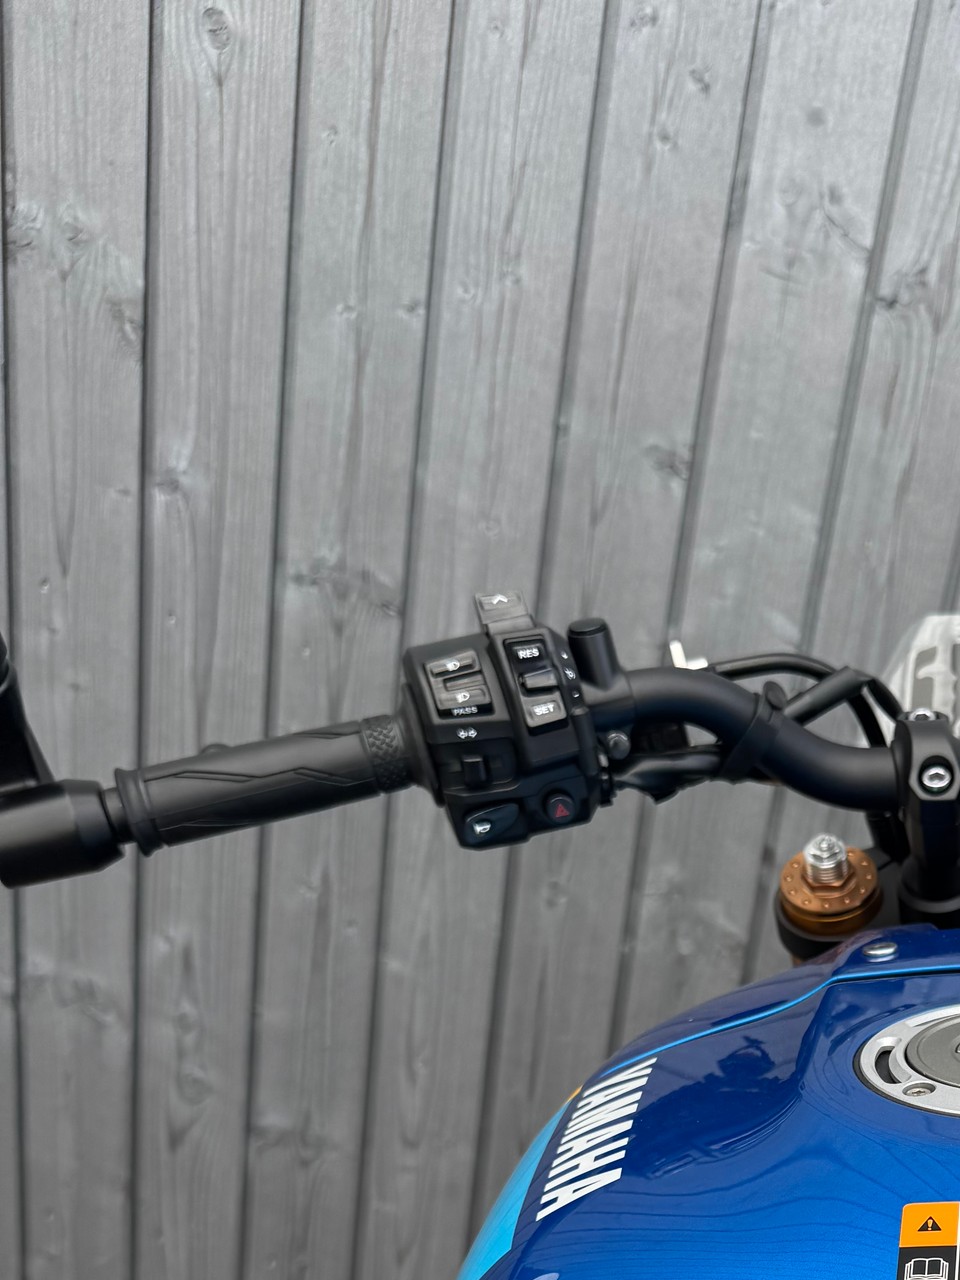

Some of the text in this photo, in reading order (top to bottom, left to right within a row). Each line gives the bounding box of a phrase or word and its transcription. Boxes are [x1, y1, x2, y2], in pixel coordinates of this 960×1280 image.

[517, 649, 540, 660] RES
[452, 706, 478, 717] PASS
[533, 704, 555, 716] SET
[535, 1057, 657, 1221] YAMAHA
